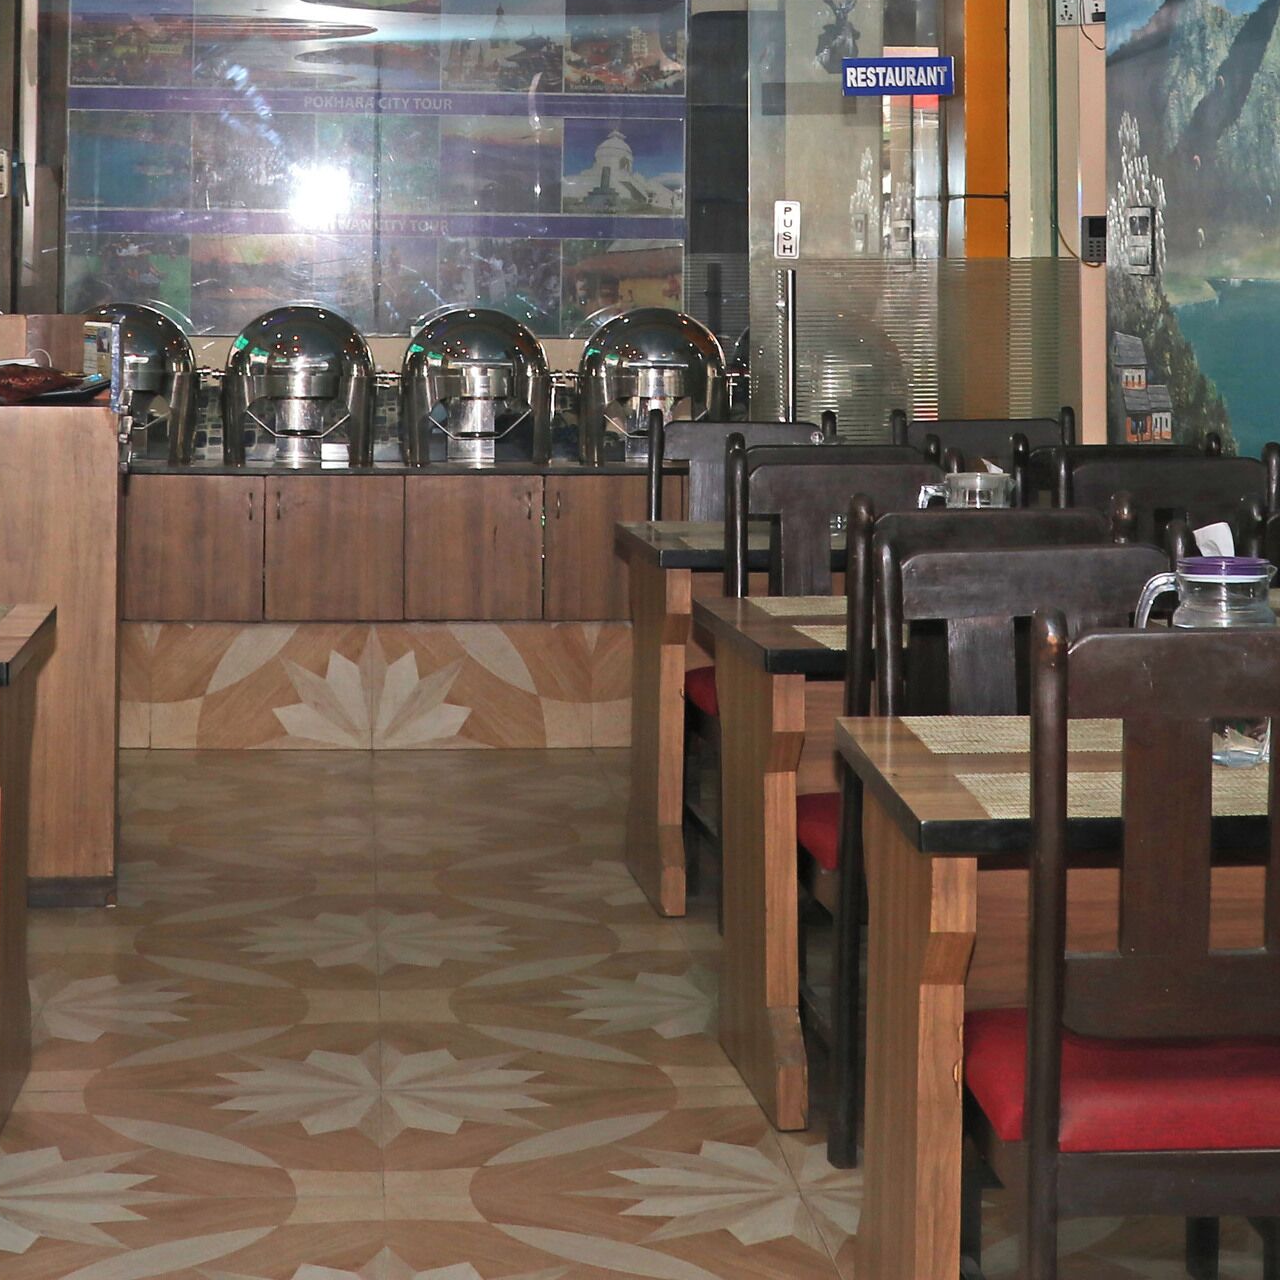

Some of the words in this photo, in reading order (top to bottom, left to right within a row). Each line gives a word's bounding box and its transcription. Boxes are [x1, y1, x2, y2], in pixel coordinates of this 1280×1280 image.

[846, 66, 948, 88] RESTAURANT
[304, 95, 374, 109] POKHARA
[378, 96, 410, 110] CITY
[413, 97, 453, 110] TOUR
[782, 206, 793, 254] PUSH
